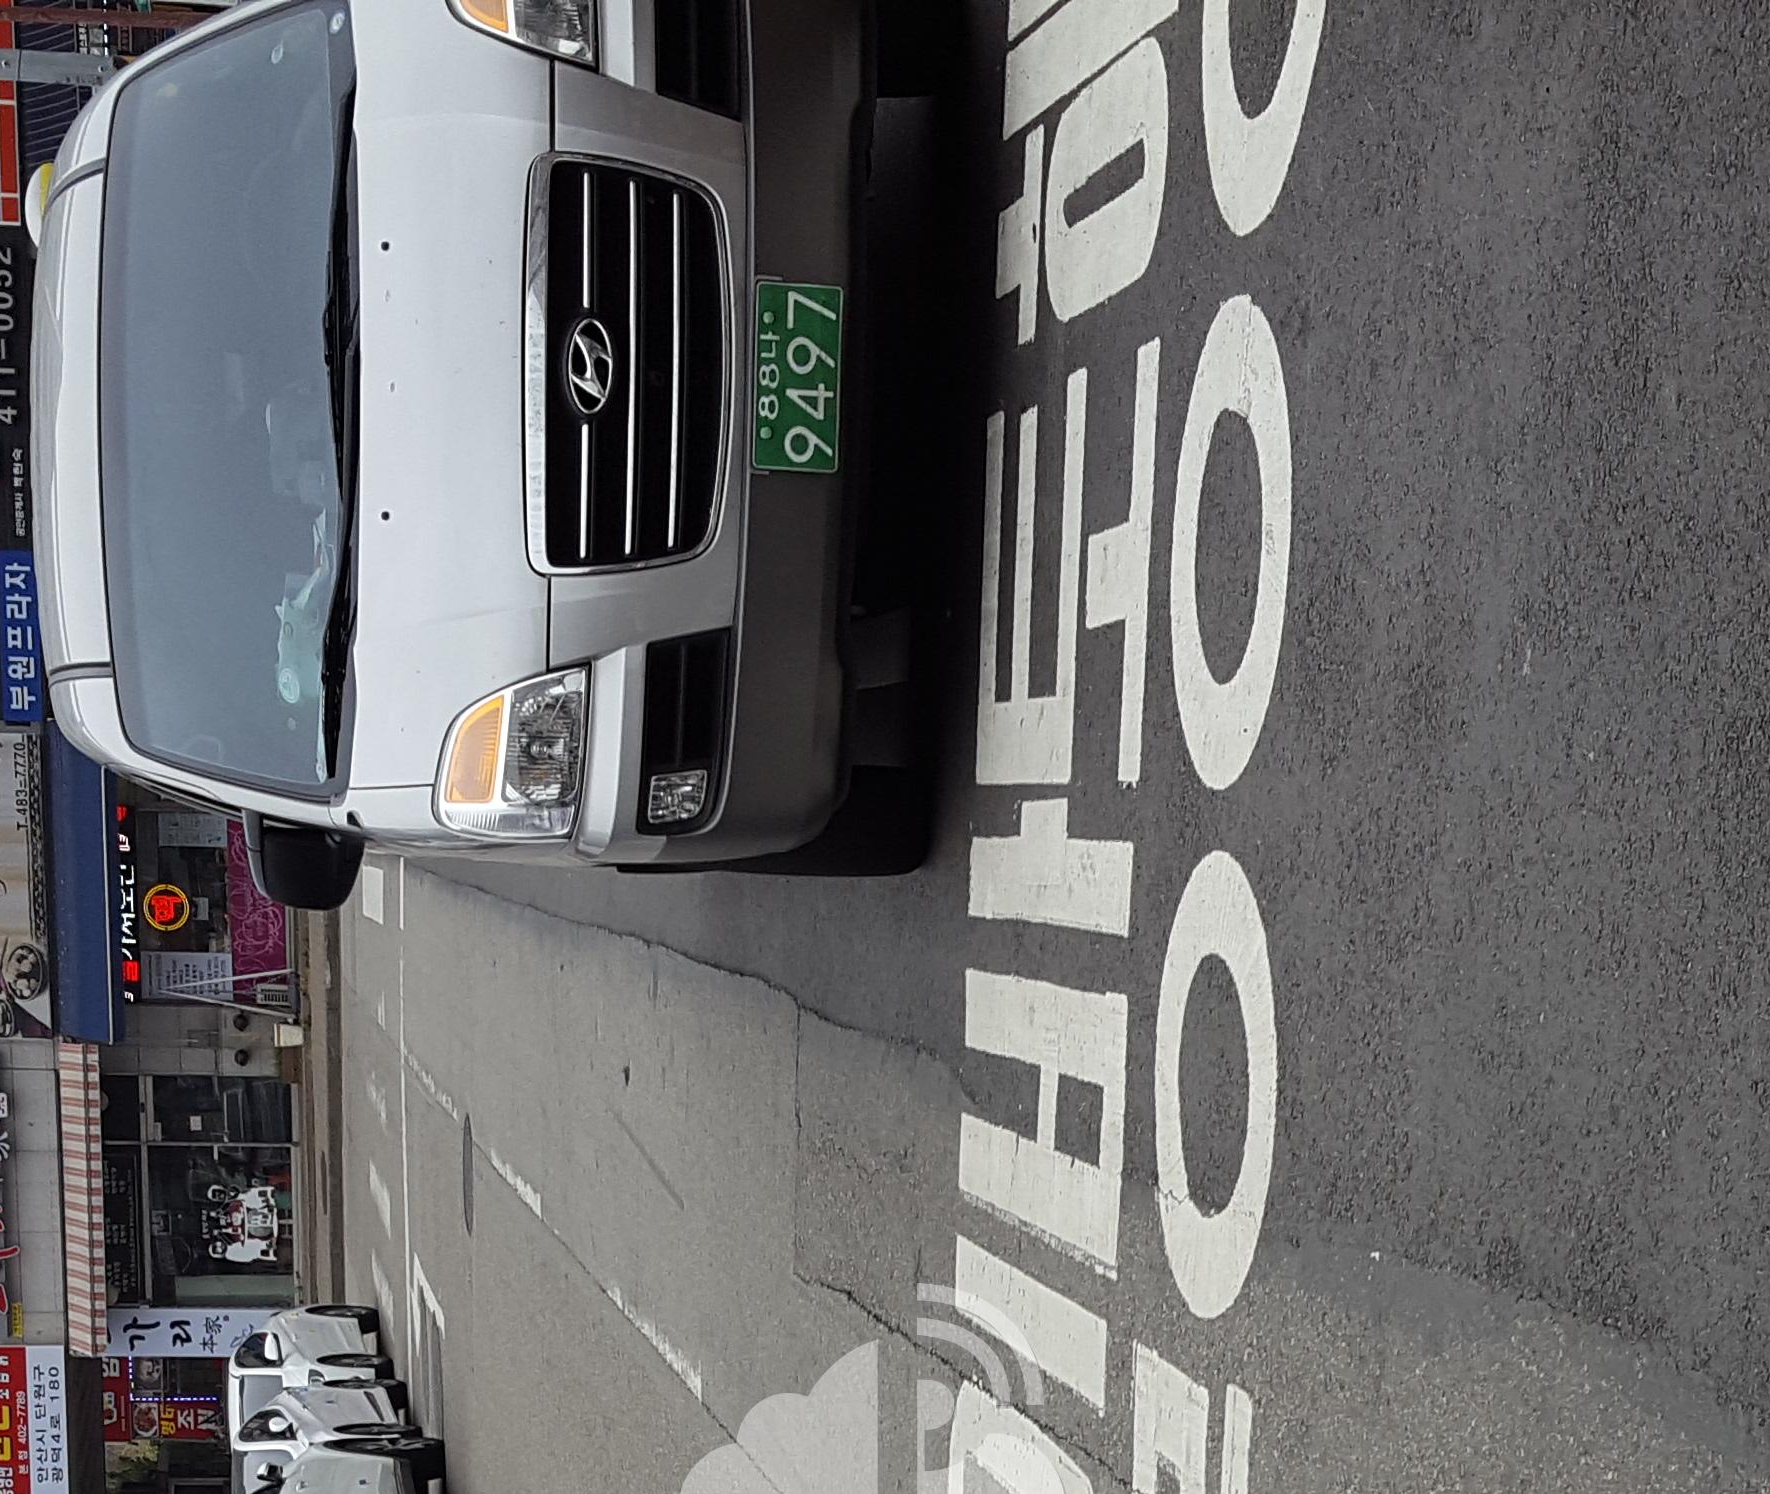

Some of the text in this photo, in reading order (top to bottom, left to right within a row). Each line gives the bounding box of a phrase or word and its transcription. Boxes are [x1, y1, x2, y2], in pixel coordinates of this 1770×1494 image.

[757, 329, 781, 420] 88나
[782, 290, 836, 465] 9497
[3, 562, 37, 711] 부원프라자
[32, 1363, 49, 1484] 안산시 단원구
[48, 1366, 60, 1403] 180
